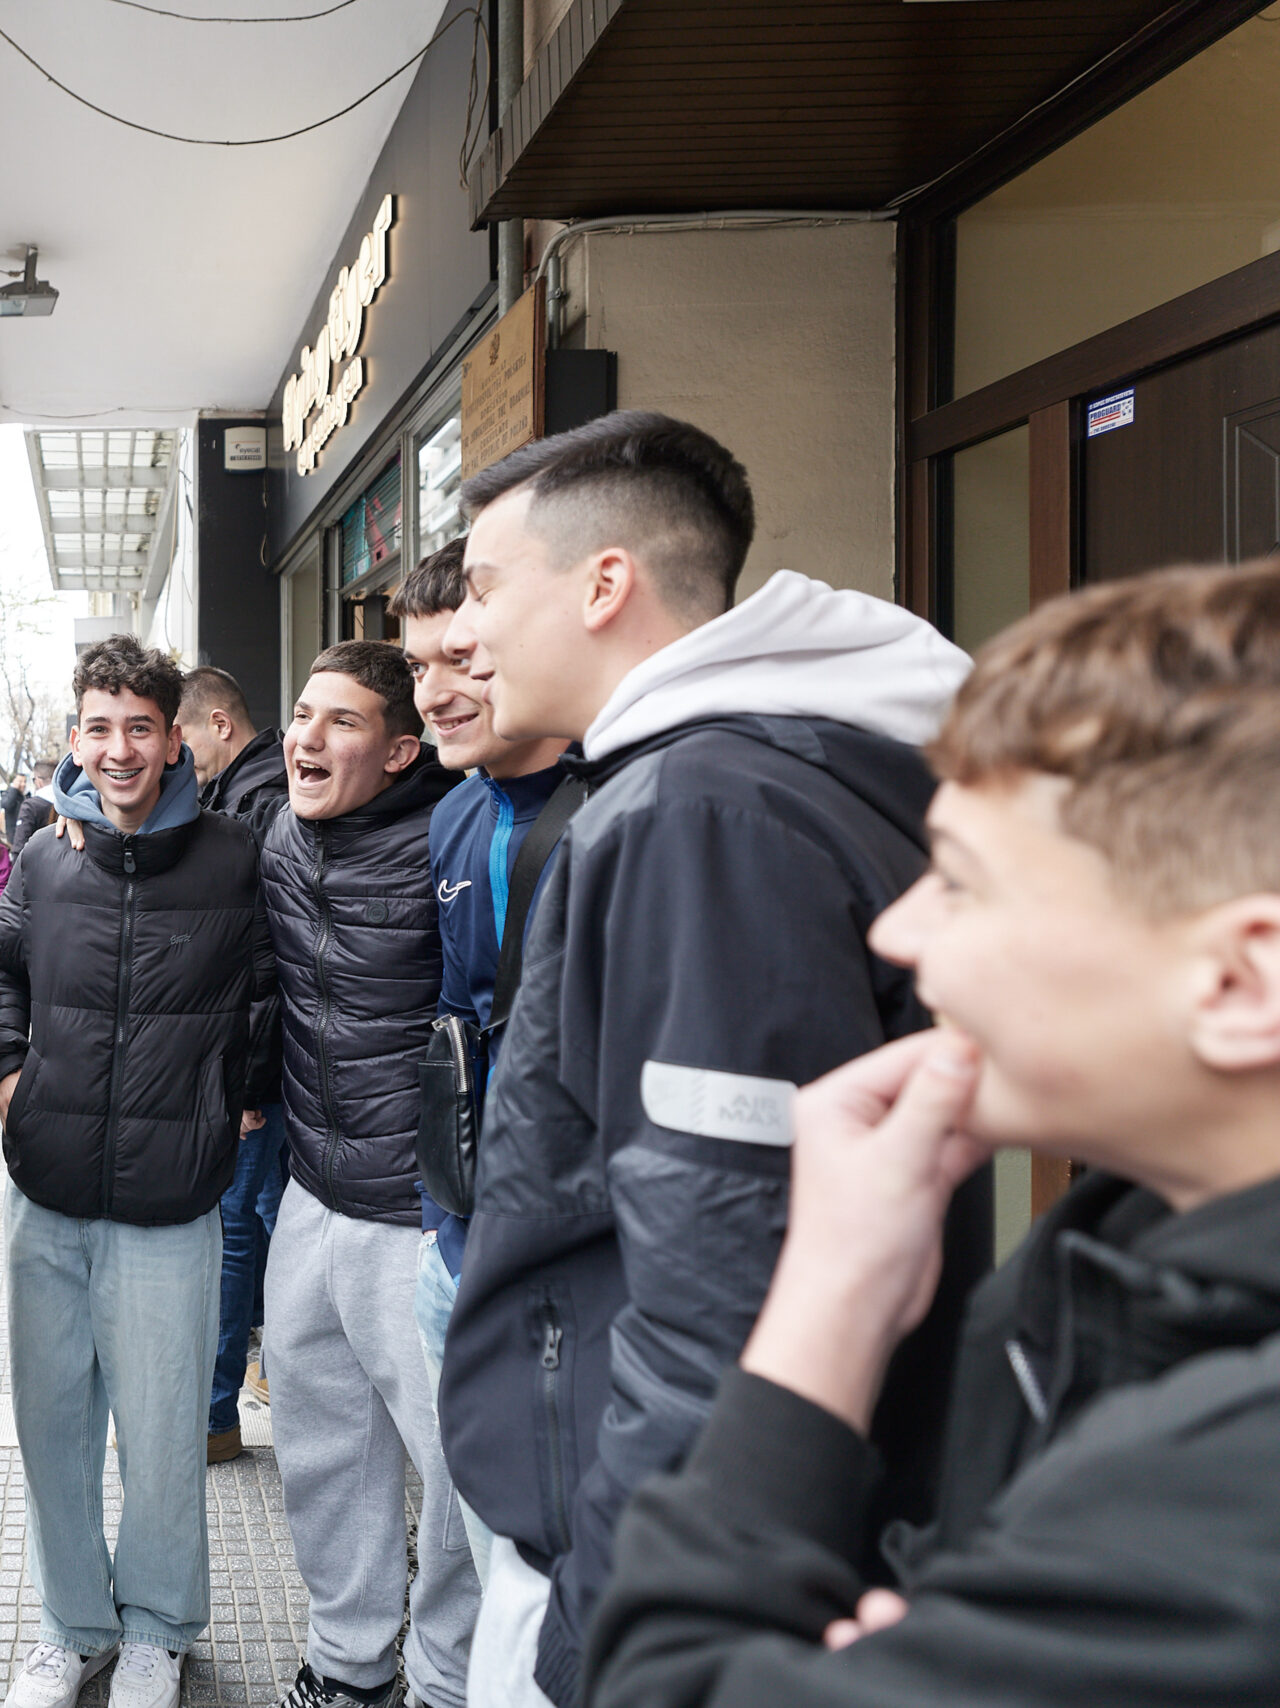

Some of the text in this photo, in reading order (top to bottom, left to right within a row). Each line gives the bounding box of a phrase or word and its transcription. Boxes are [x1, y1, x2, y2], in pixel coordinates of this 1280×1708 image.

[328, 194, 392, 363] tiger
[1090, 403, 1122, 421] PROGUARD
[731, 1093, 777, 1111] AIR
[719, 1105, 782, 1128] MAX
